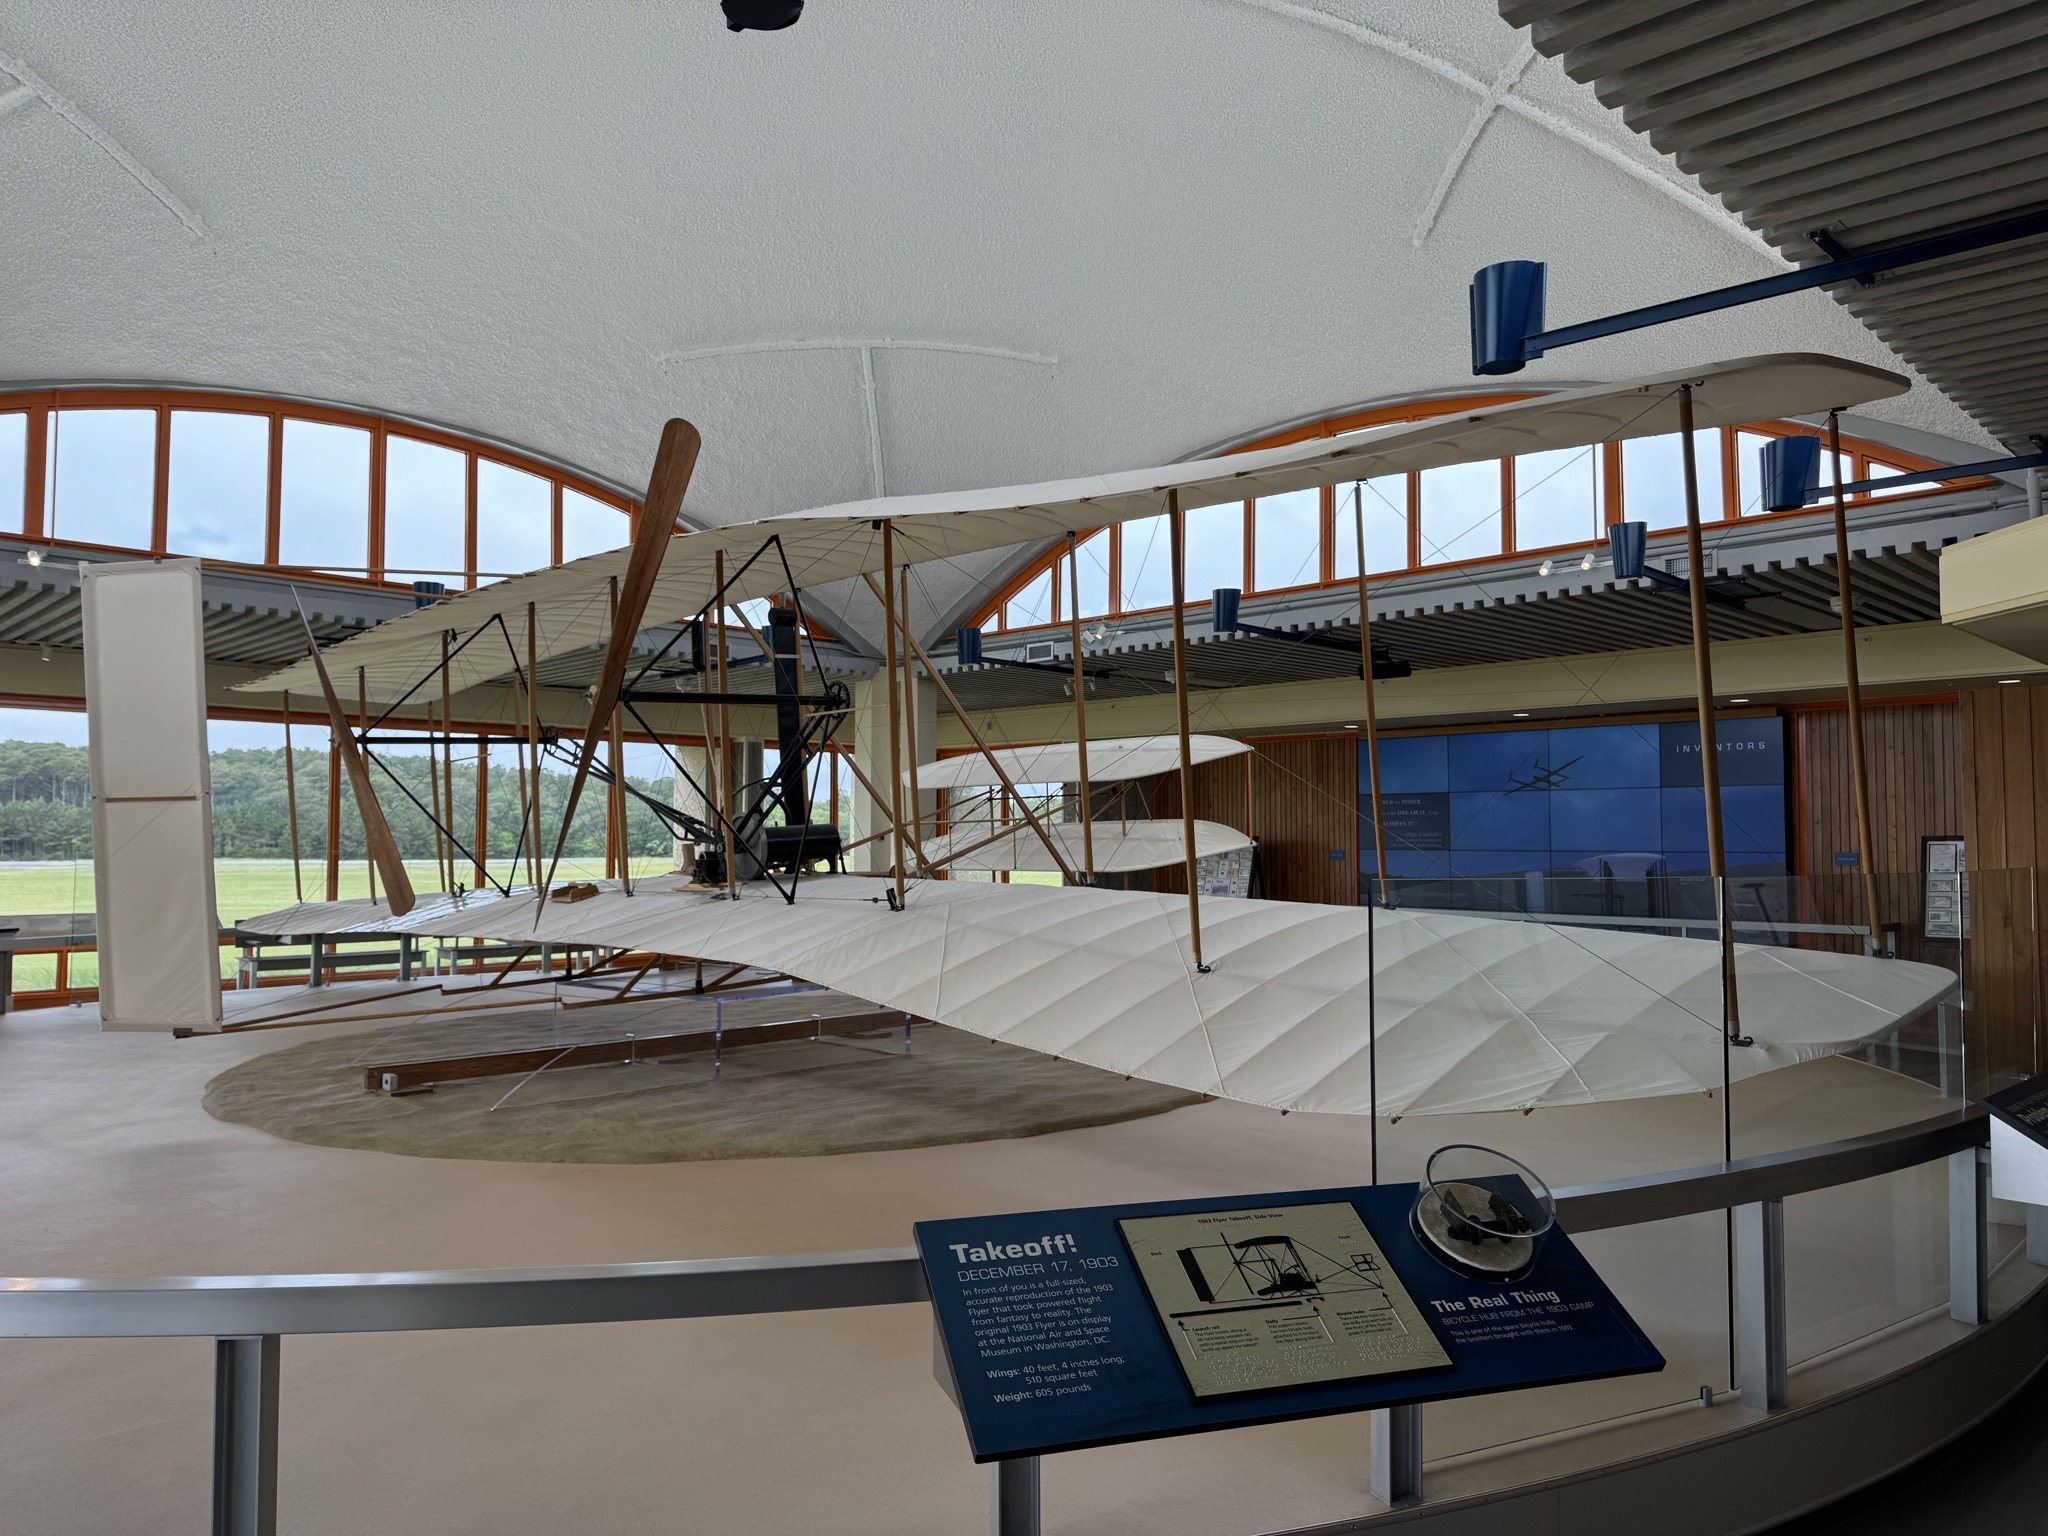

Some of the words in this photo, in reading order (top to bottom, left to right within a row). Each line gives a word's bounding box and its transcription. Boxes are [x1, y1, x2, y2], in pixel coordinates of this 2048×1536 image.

[1676, 741, 1765, 752] INVNTORS
[949, 1234, 1077, 1263] Takeoff!
[958, 1263, 1044, 1282] DECEMBER
[1051, 1260, 1072, 1273] 17,
[1079, 1256, 1119, 1269] 1903
[966, 1296, 1003, 1306] accurate
[1005, 1290, 1062, 1302] reproduction
[1064, 1287, 1074, 1295] of
[1076, 1286, 1091, 1294] the
[1093, 1284, 1113, 1292] 1903
[974, 1286, 998, 1295] front
[999, 1284, 1008, 1292] of
[1010, 1284, 1027, 1293] you
[1046, 1277, 1086, 1287] full-sized,
[968, 1308, 989, 1317] Flyer
[992, 1305, 1012, 1313] that
[1013, 1302, 1034, 1311] took
[1036, 1298, 1076, 1309] powered
[1077, 1295, 1102, 1304] flight
[1430, 1300, 1466, 1313] The
[1467, 1293, 1509, 1309] Real
[1509, 1290, 1561, 1303] Thing
[971, 1318, 994, 1326] from
[996, 1314, 1029, 1323] fantasy
[1044, 1309, 1073, 1317] reality.
[1441, 1314, 1479, 1325] BICYCLE
[1479, 1311, 1500, 1321] HUB
[1500, 1309, 1527, 1318] FROM
[1526, 1306, 1545, 1315] THE
[1546, 1304, 1569, 1313] 1903
[1569, 1301, 1594, 1311] CAMP
[975, 1325, 1009, 1337] original
[1012, 1323, 1033, 1332] 1903
[1034, 1321, 1056, 1330] Flyer
[1058, 1319, 1066, 1327] is
[1081, 1315, 1111, 1324] display
[978, 1339, 988, 1347] at
[990, 1337, 1006, 1345] the
[1007, 1332, 1046, 1343] National
[1049, 1331, 1062, 1339] Air
[1064, 1328, 1082, 1337] and
[1083, 1326, 1110, 1336] Space
[980, 1346, 1022, 1357] Museum
[1034, 1339, 1092, 1350] Washington,
[1093, 1335, 1111, 1344] DC.
[986, 1369, 1021, 1378] Wings:
[1023, 1365, 1035, 1374] 40
[1037, 1363, 1060, 1372] feet,
[1061, 1361, 1068, 1369] 4
[1069, 1359, 1100, 1368] inches
[1101, 1356, 1125, 1365] long;
[1025, 1375, 1042, 1385] 510
[1044, 1372, 1076, 1383] square
[1078, 1369, 1099, 1378] feet
[993, 1391, 1034, 1403] Weight:
[1035, 1388, 1054, 1397] 605
[1055, 1383, 1092, 1396] pounds
